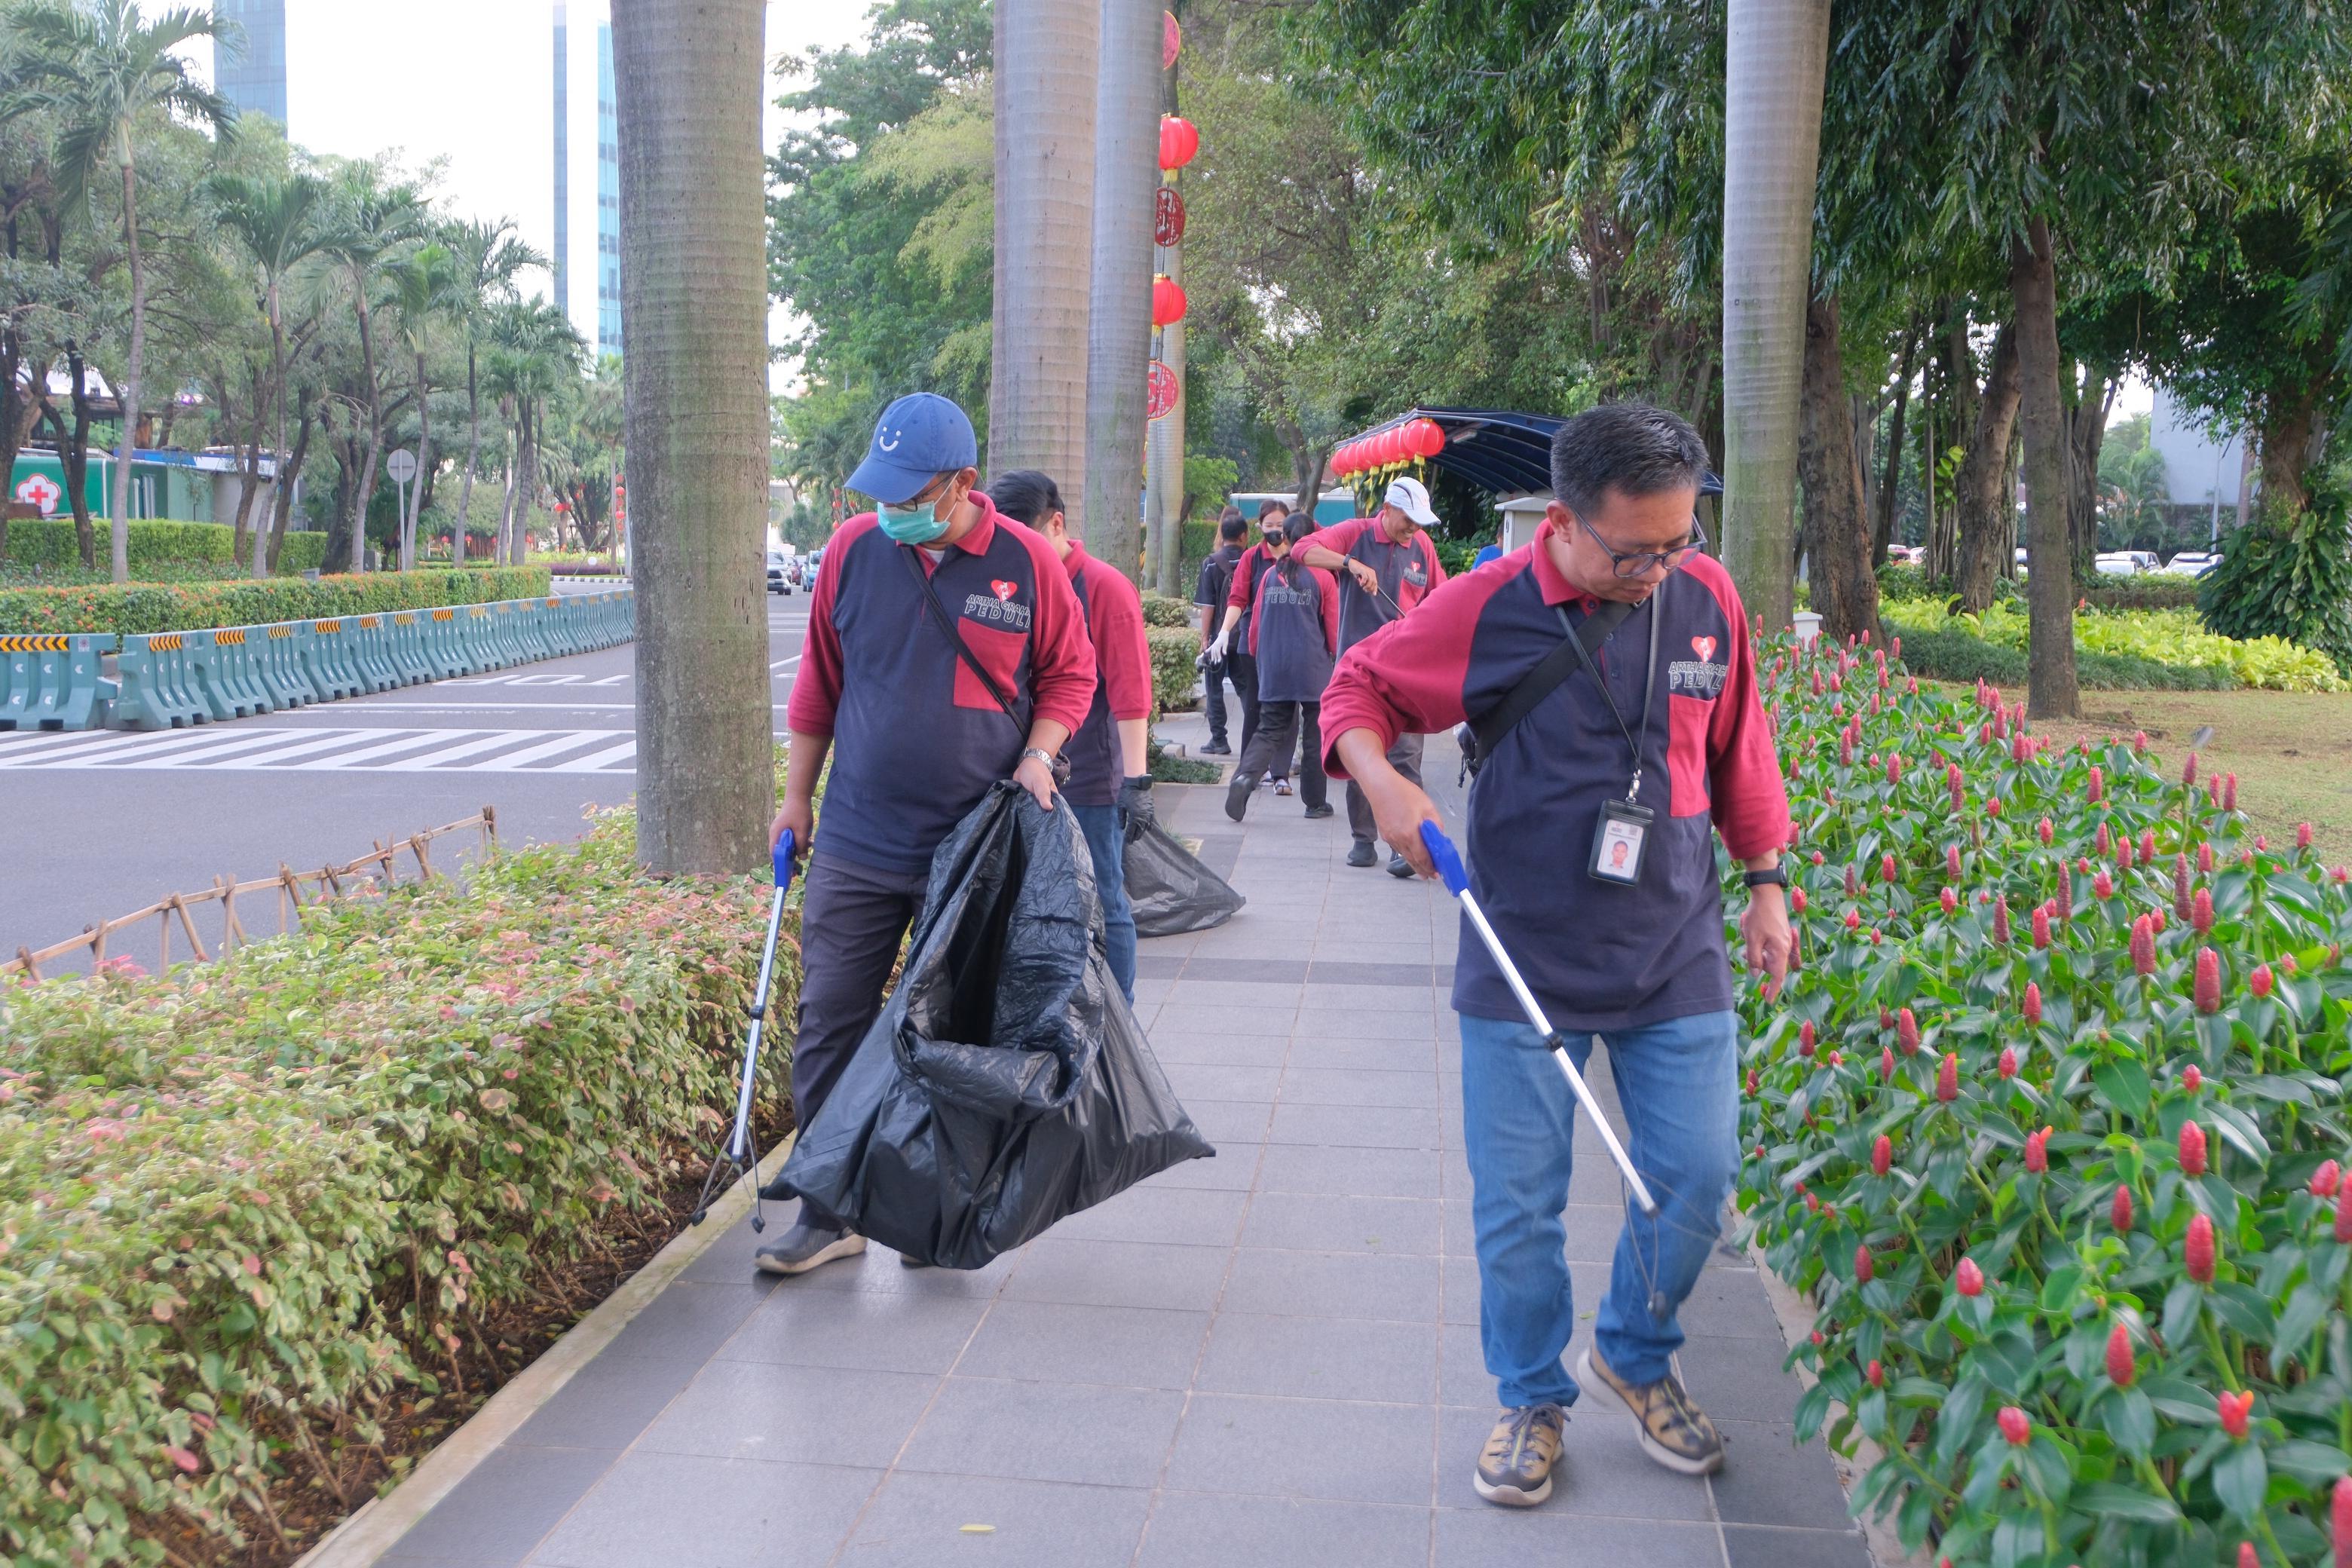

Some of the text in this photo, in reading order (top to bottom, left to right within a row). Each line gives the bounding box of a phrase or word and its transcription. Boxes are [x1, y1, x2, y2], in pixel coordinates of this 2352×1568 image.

[966, 594, 1000, 608] ARTHA
[964, 602, 1031, 628] PEDULI
[1668, 661, 1704, 675] ARTHA
[432, 674, 631, 686] TOP
